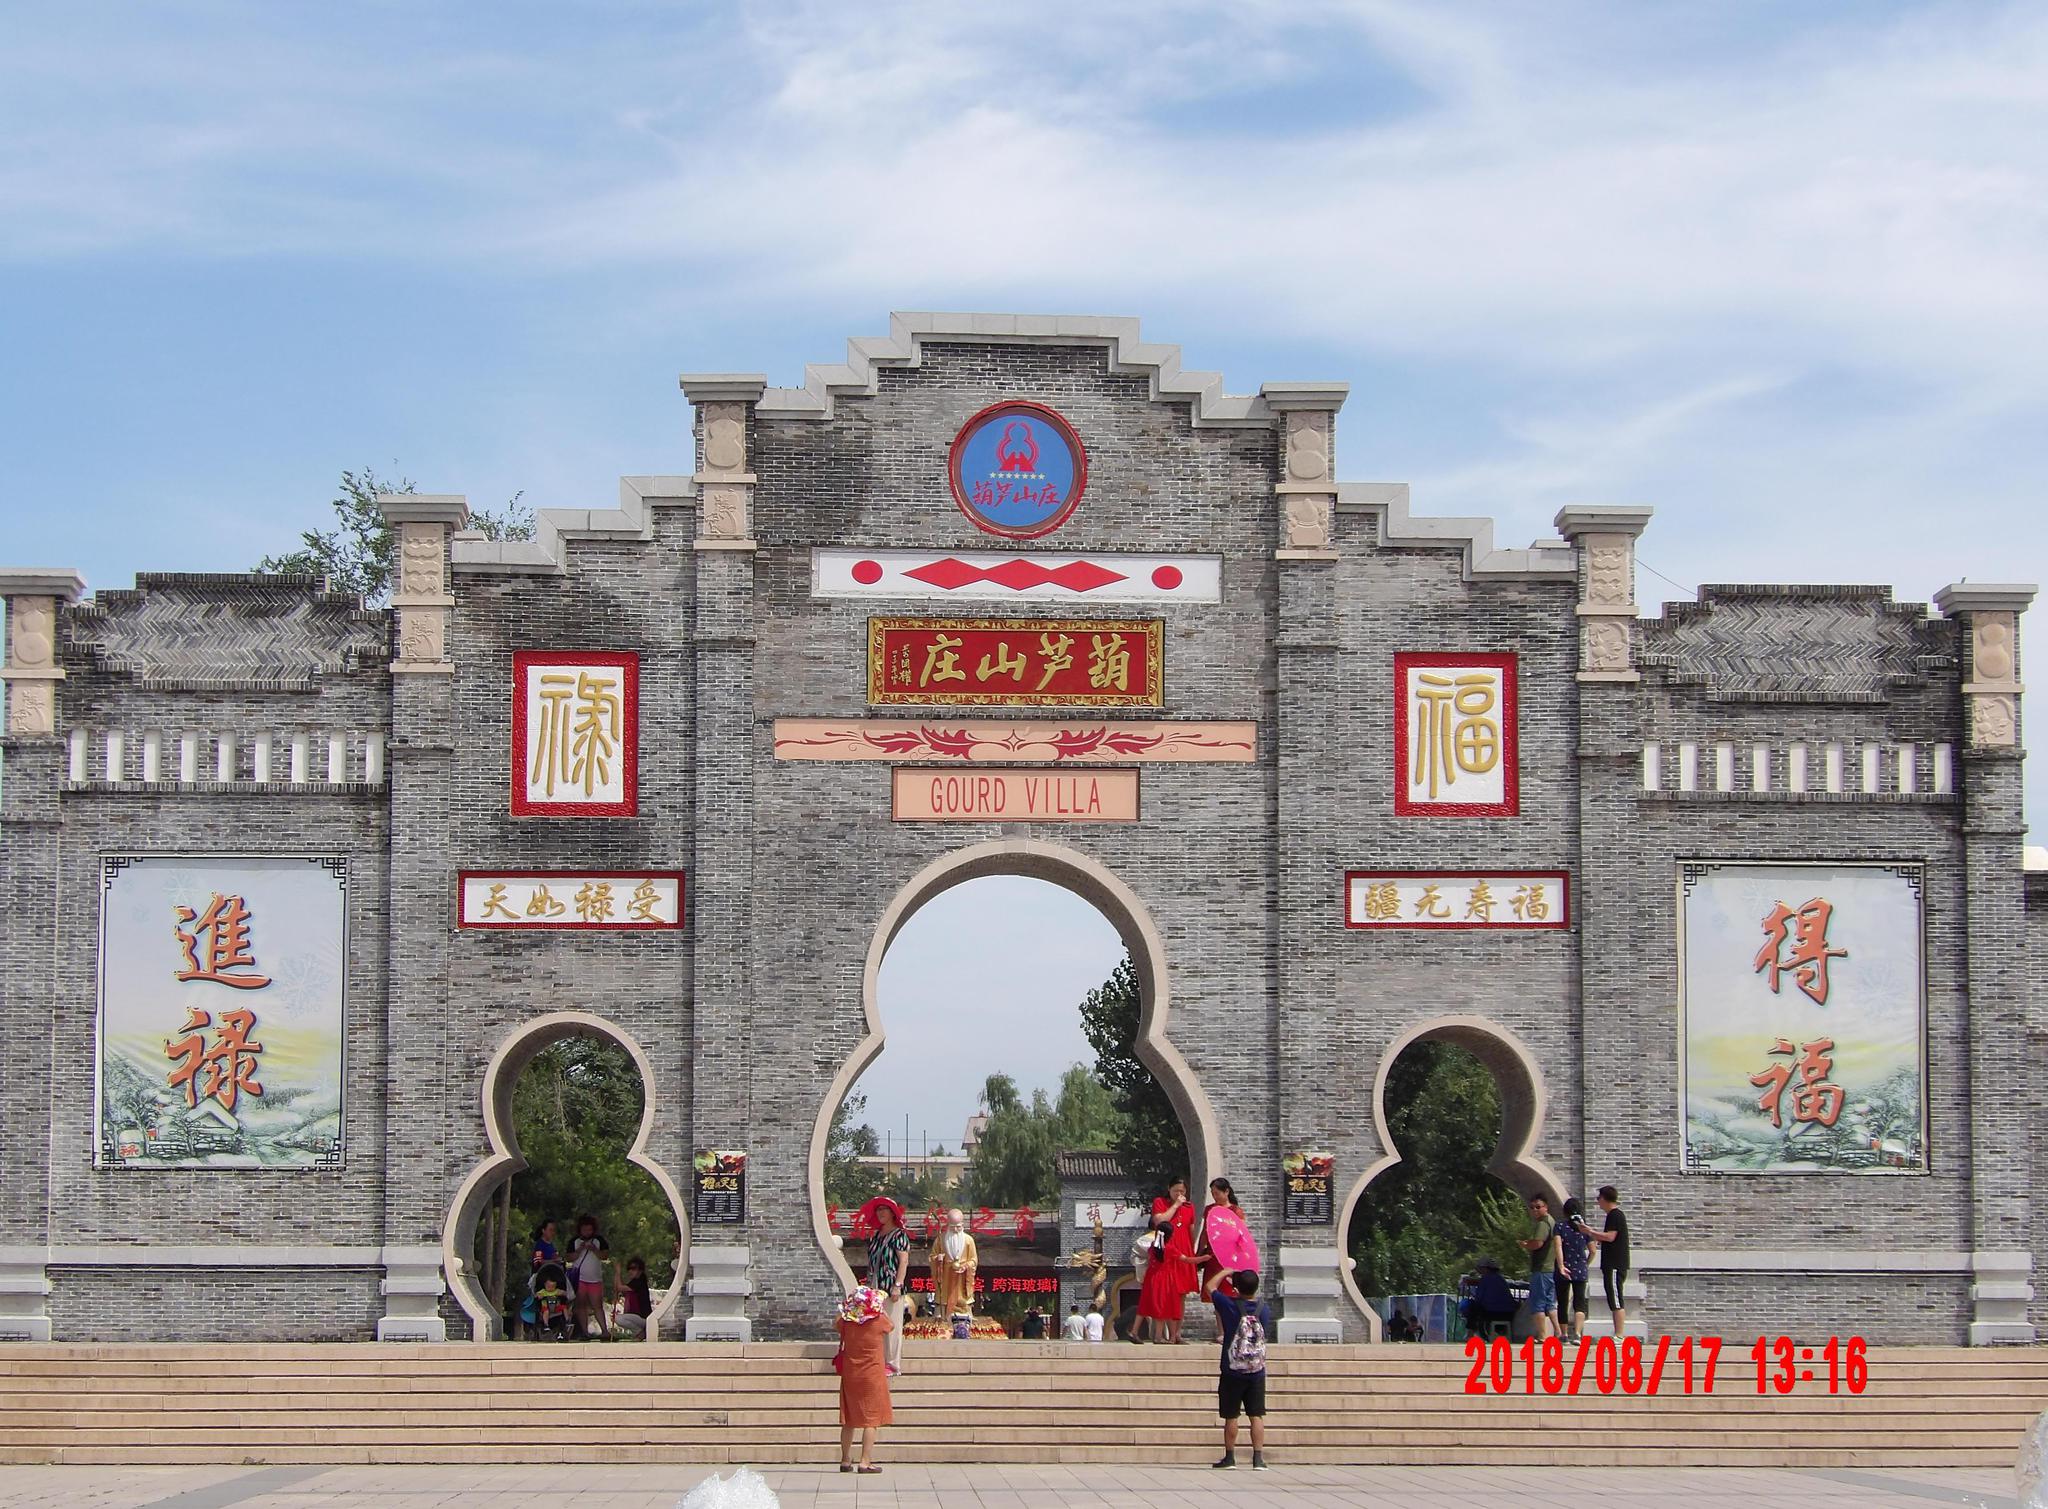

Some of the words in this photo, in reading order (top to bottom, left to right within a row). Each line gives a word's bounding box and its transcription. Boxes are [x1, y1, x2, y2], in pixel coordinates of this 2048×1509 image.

[973, 480, 1060, 508] 葫芦山庄
[1415, 673, 1500, 798] 福
[930, 776, 1007, 815] GOURD
[1024, 777, 1102, 815] VILLA
[1749, 897, 1849, 1128] 得福
